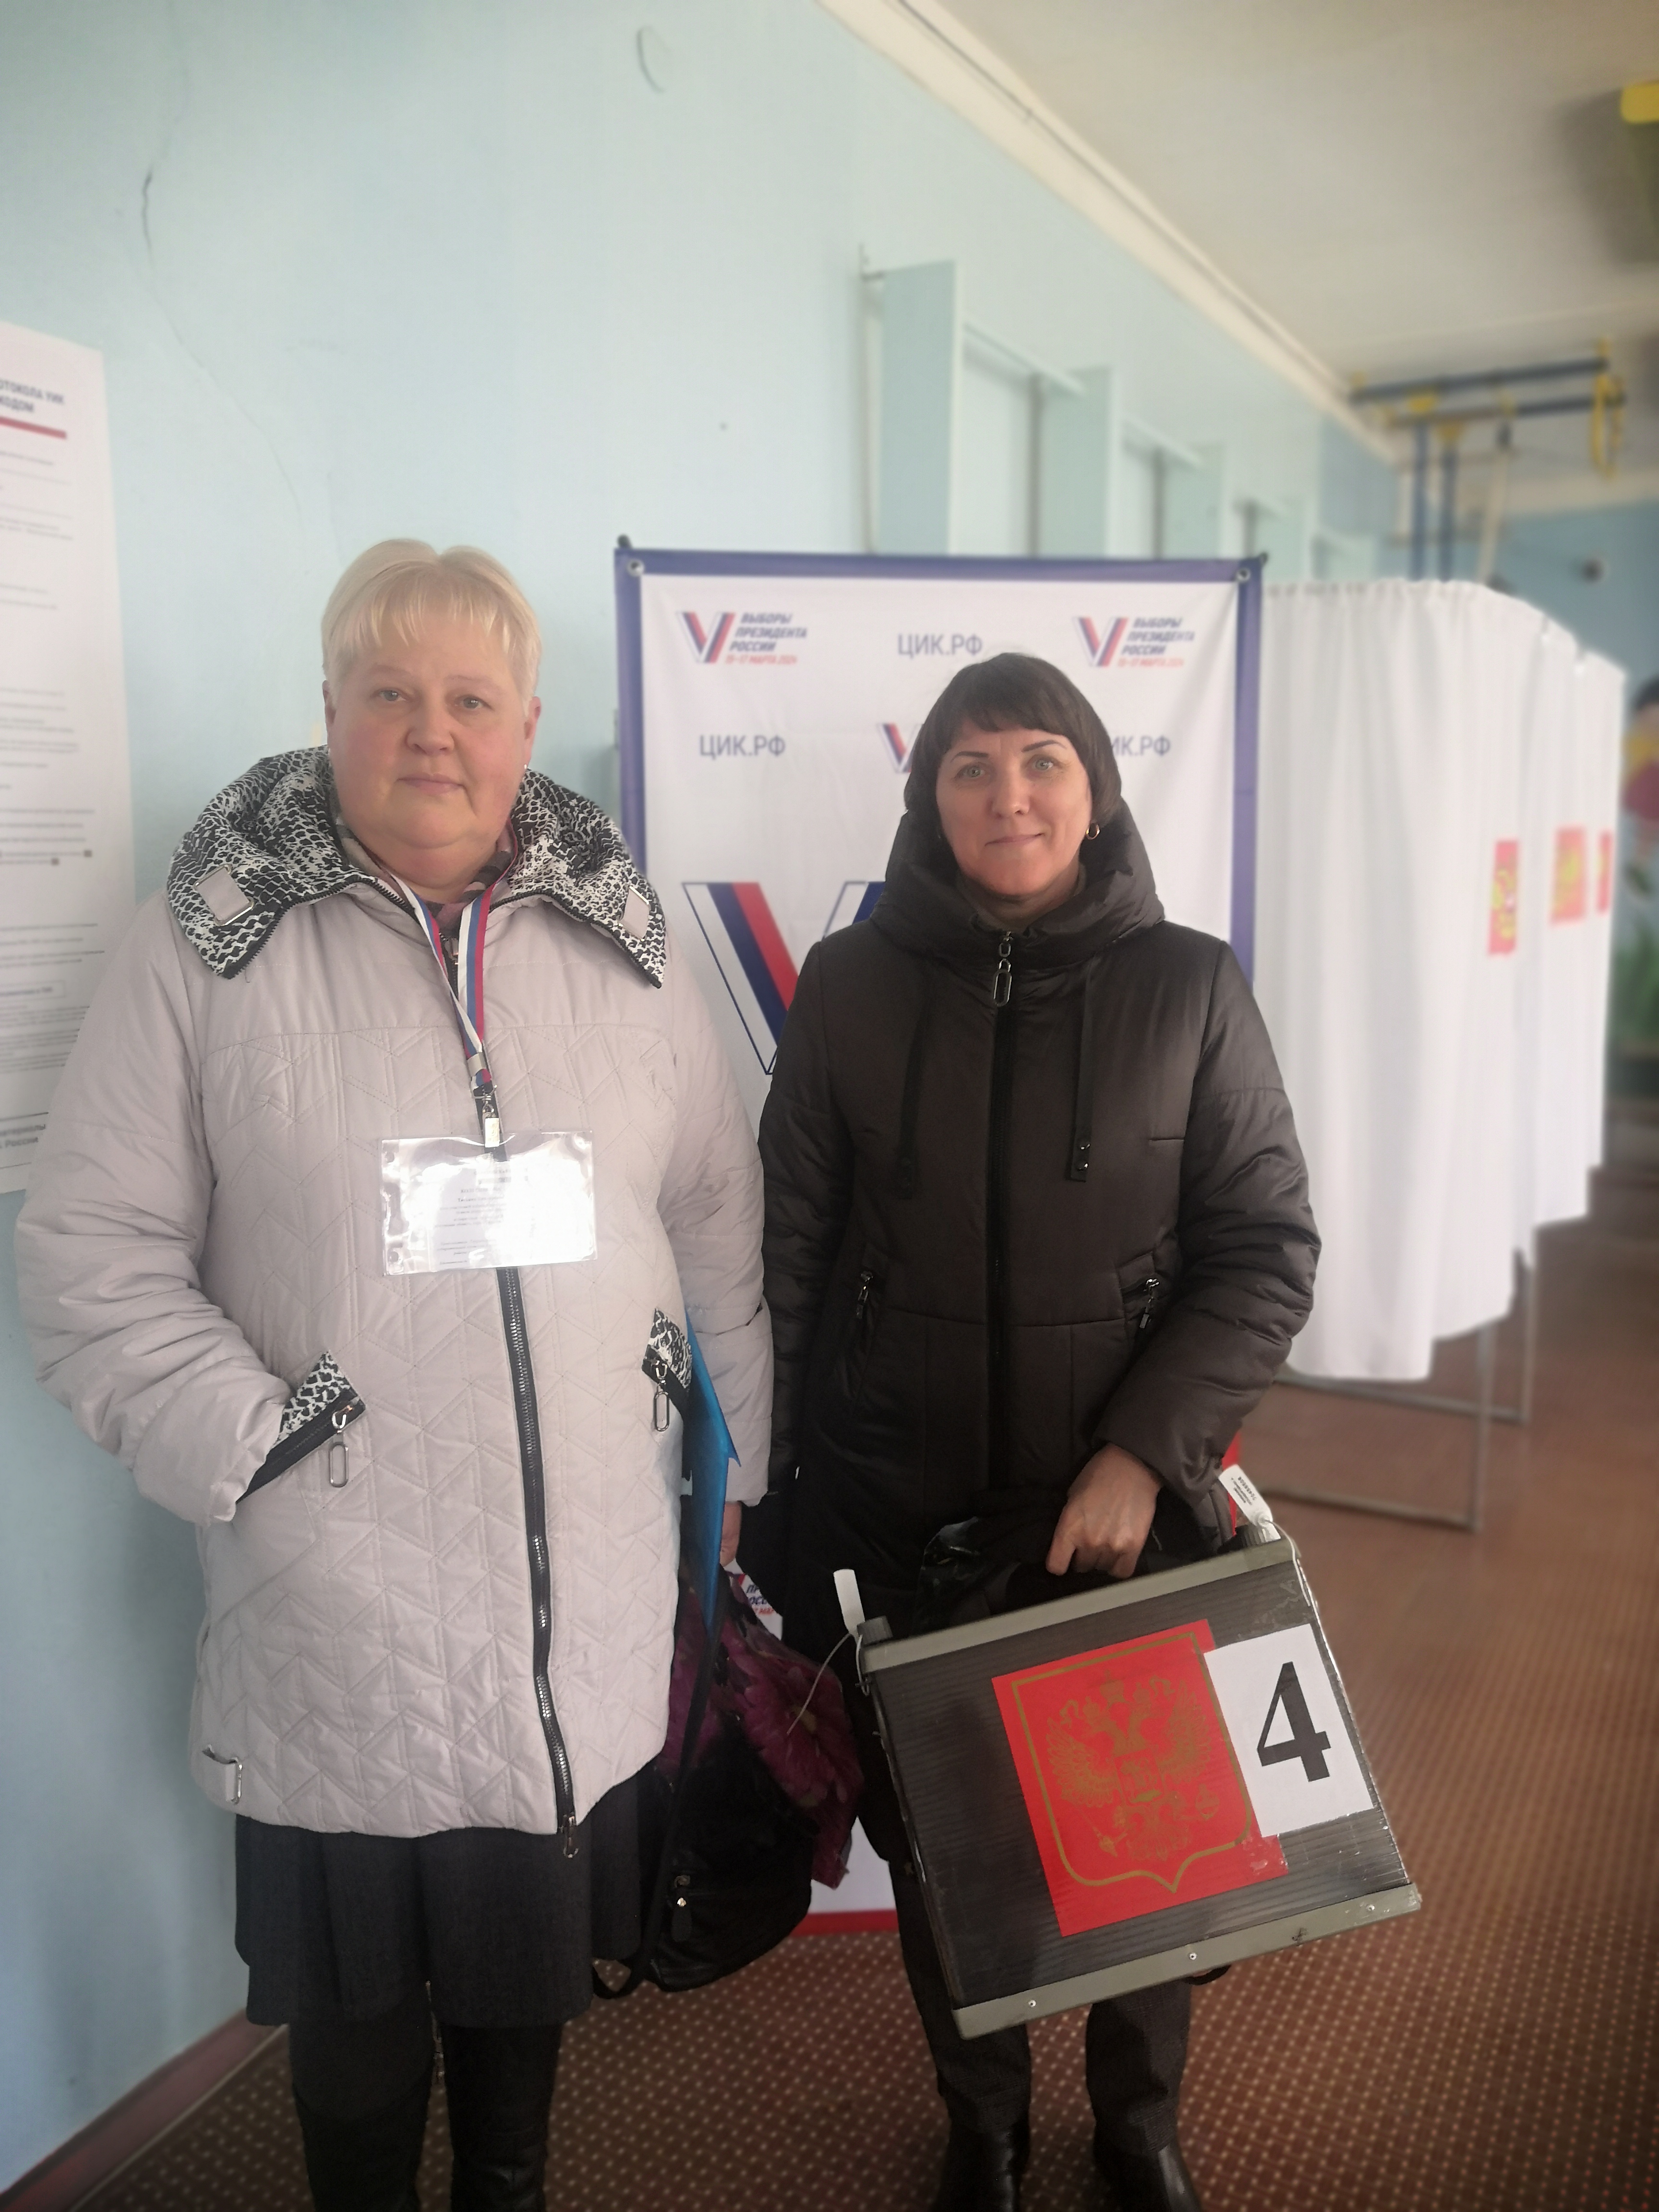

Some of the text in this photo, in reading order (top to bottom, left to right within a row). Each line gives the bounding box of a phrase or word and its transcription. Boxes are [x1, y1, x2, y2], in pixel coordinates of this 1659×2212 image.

[741, 613, 793, 624] ВЫБОРЫ
[1133, 617, 1182, 628] ВЫБОРЫ
[734, 627, 807, 637] ПРЕЗИДЕНТА
[1127, 631, 1195, 641] ПРЕЗИДЕНТА
[729, 641, 777, 651] РОССИИ
[898, 633, 982, 660] ЦИК.РФ
[1121, 645, 1166, 655] РОССИИ
[700, 734, 786, 760] ЦИК.РФ
[1111, 734, 1171, 757] ИК.РФ
[1257, 1661, 1331, 1782] 4
